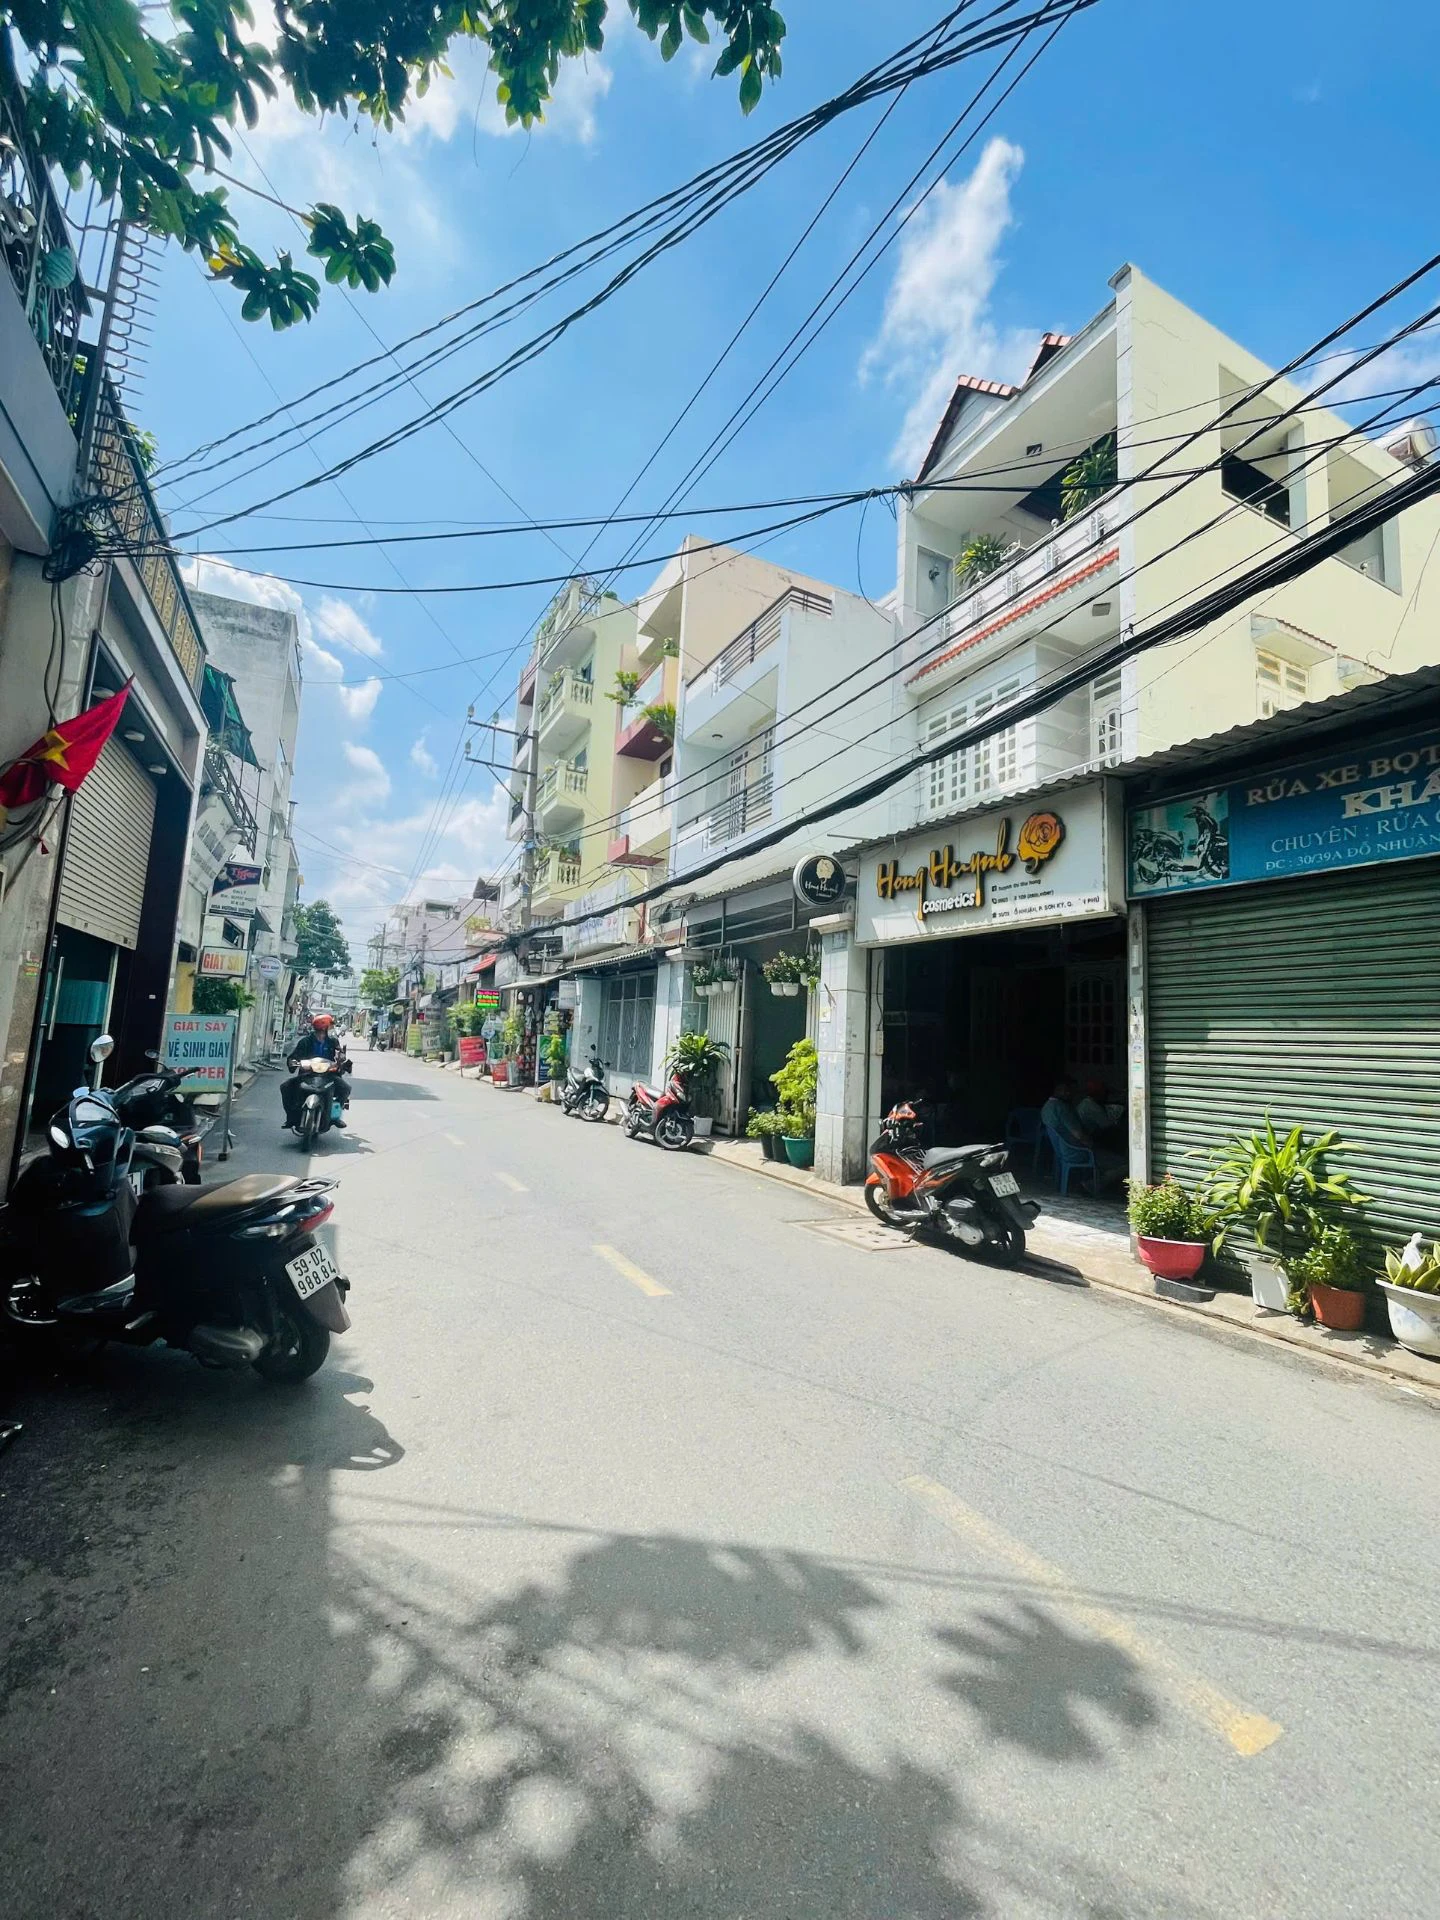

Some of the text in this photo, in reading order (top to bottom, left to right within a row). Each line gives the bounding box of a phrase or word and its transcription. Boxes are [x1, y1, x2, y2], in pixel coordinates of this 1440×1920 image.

[1247, 777, 1310, 806] RỬA
[1315, 764, 1361, 791] XE
[1271, 825, 1358, 853] CHUYÊN
[1377, 811, 1429, 835] RỬA
[182, 1041, 206, 1058] SINH
[297, 1261, 337, 1295] 988.84
